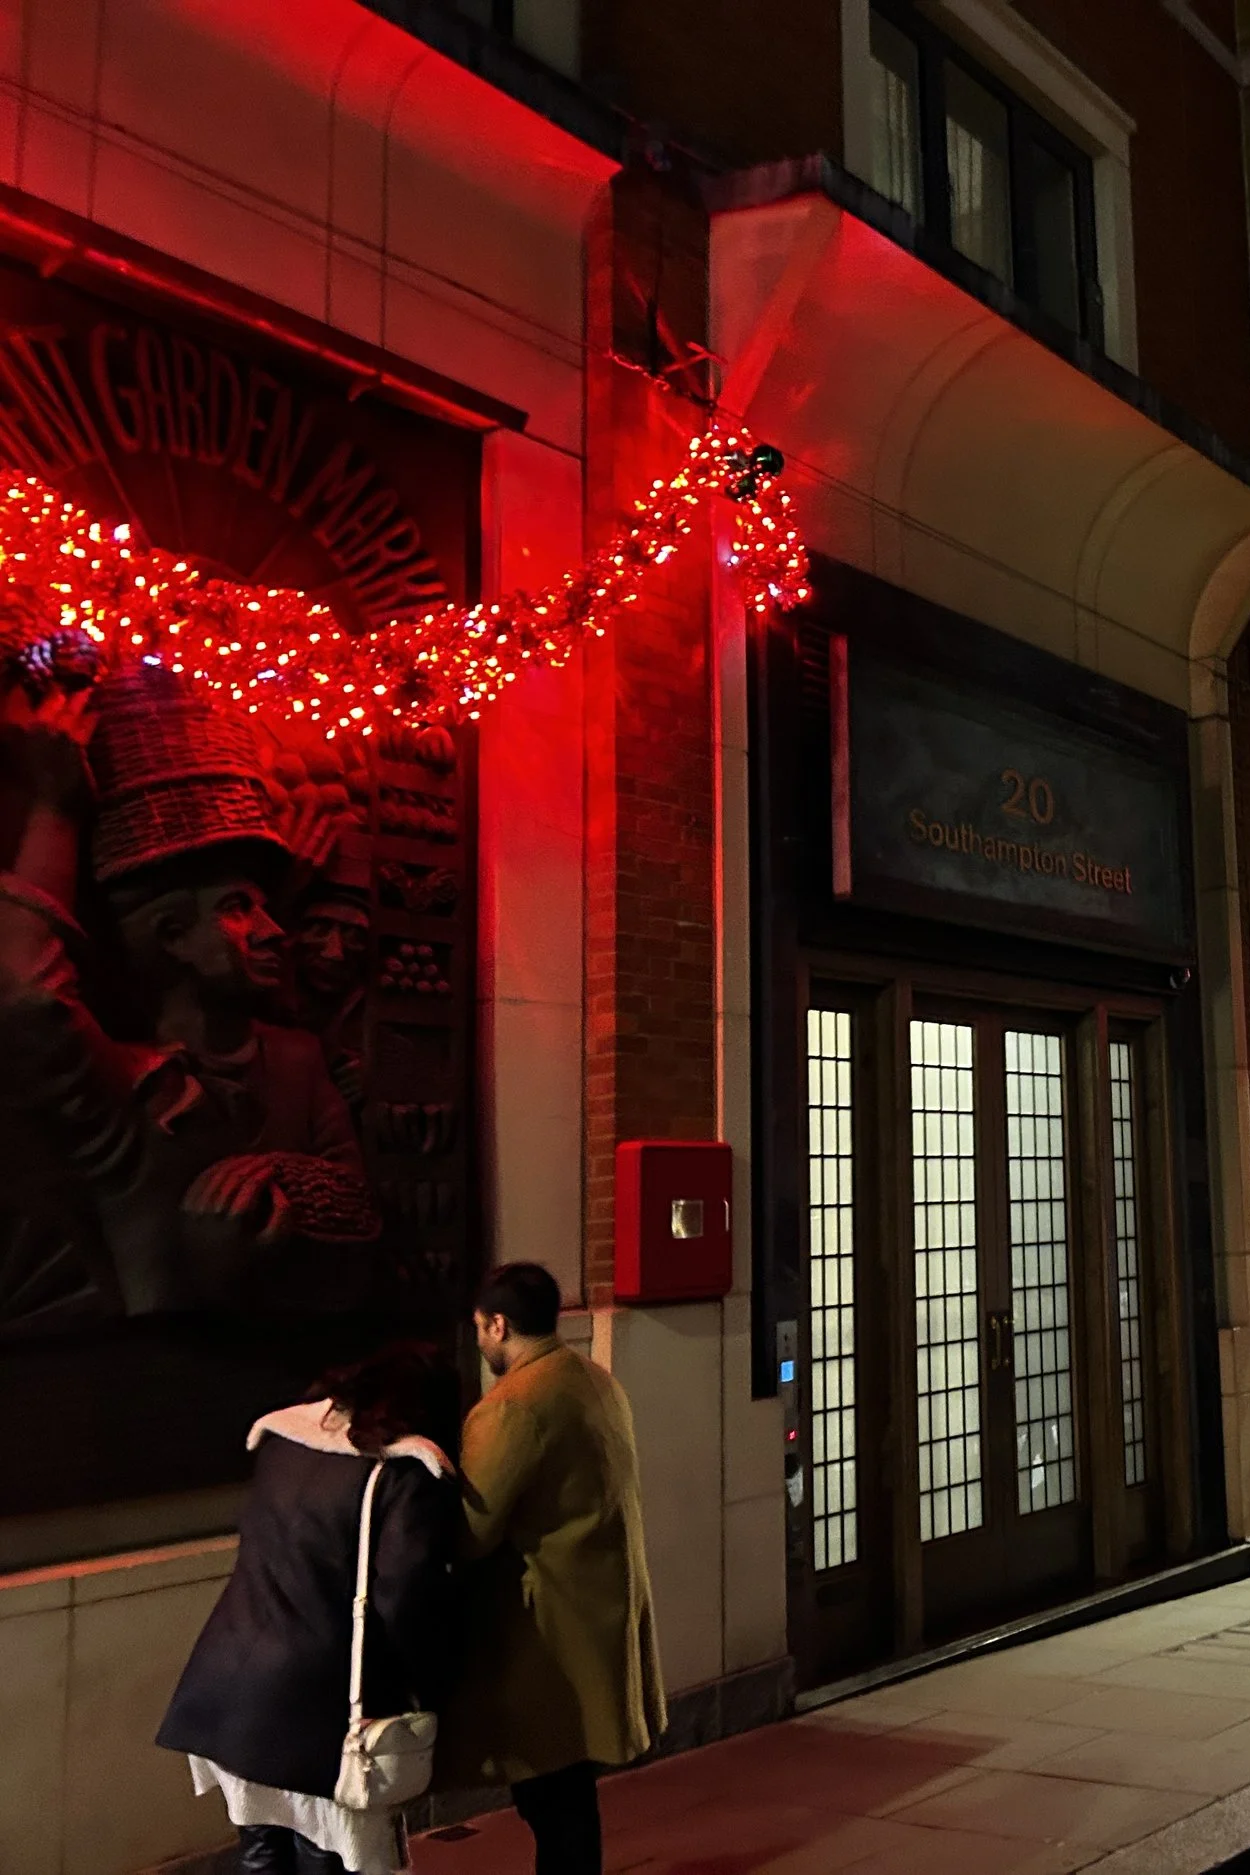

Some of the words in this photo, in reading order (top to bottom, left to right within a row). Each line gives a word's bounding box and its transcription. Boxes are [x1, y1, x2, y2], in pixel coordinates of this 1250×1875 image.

[89, 322, 318, 504] GARDEN
[998, 766, 1056, 826] 20
[907, 807, 1067, 878] Southampton
[1071, 850, 1134, 897] Street
